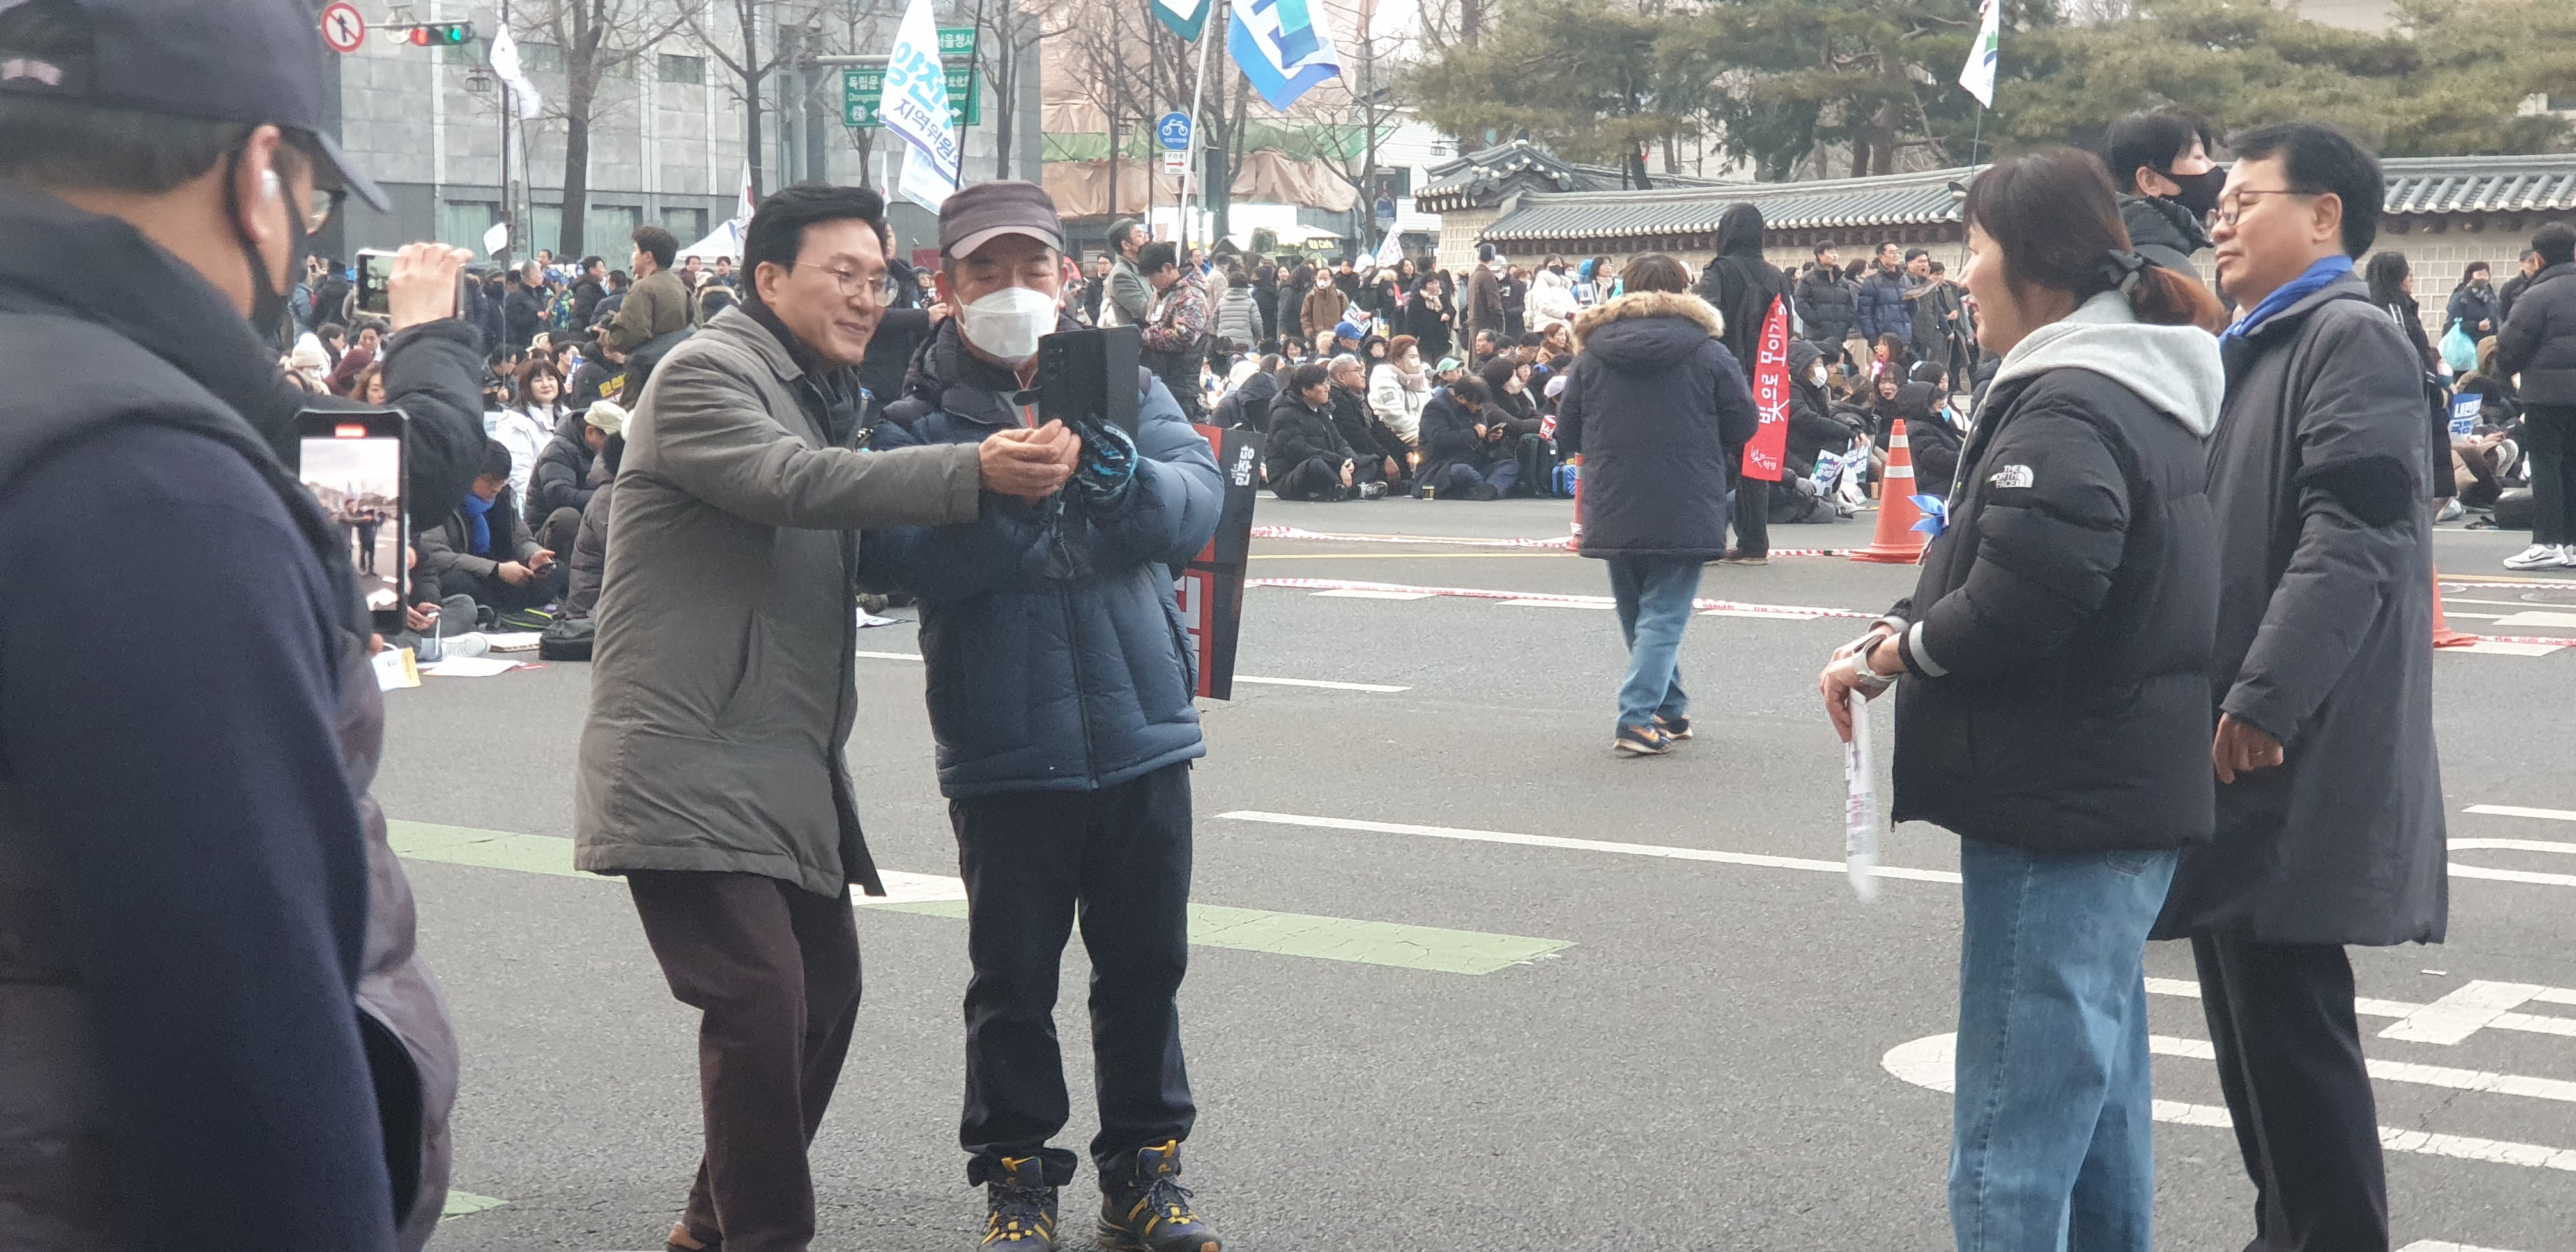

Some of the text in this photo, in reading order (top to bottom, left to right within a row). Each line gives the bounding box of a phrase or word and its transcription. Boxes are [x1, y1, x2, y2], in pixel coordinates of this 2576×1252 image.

[848, 75, 878, 90] 독립문
[855, 109, 864, 118] 21
[1758, 374, 1790, 424] 빛으로
[1235, 445, 1255, 486] 민주당
